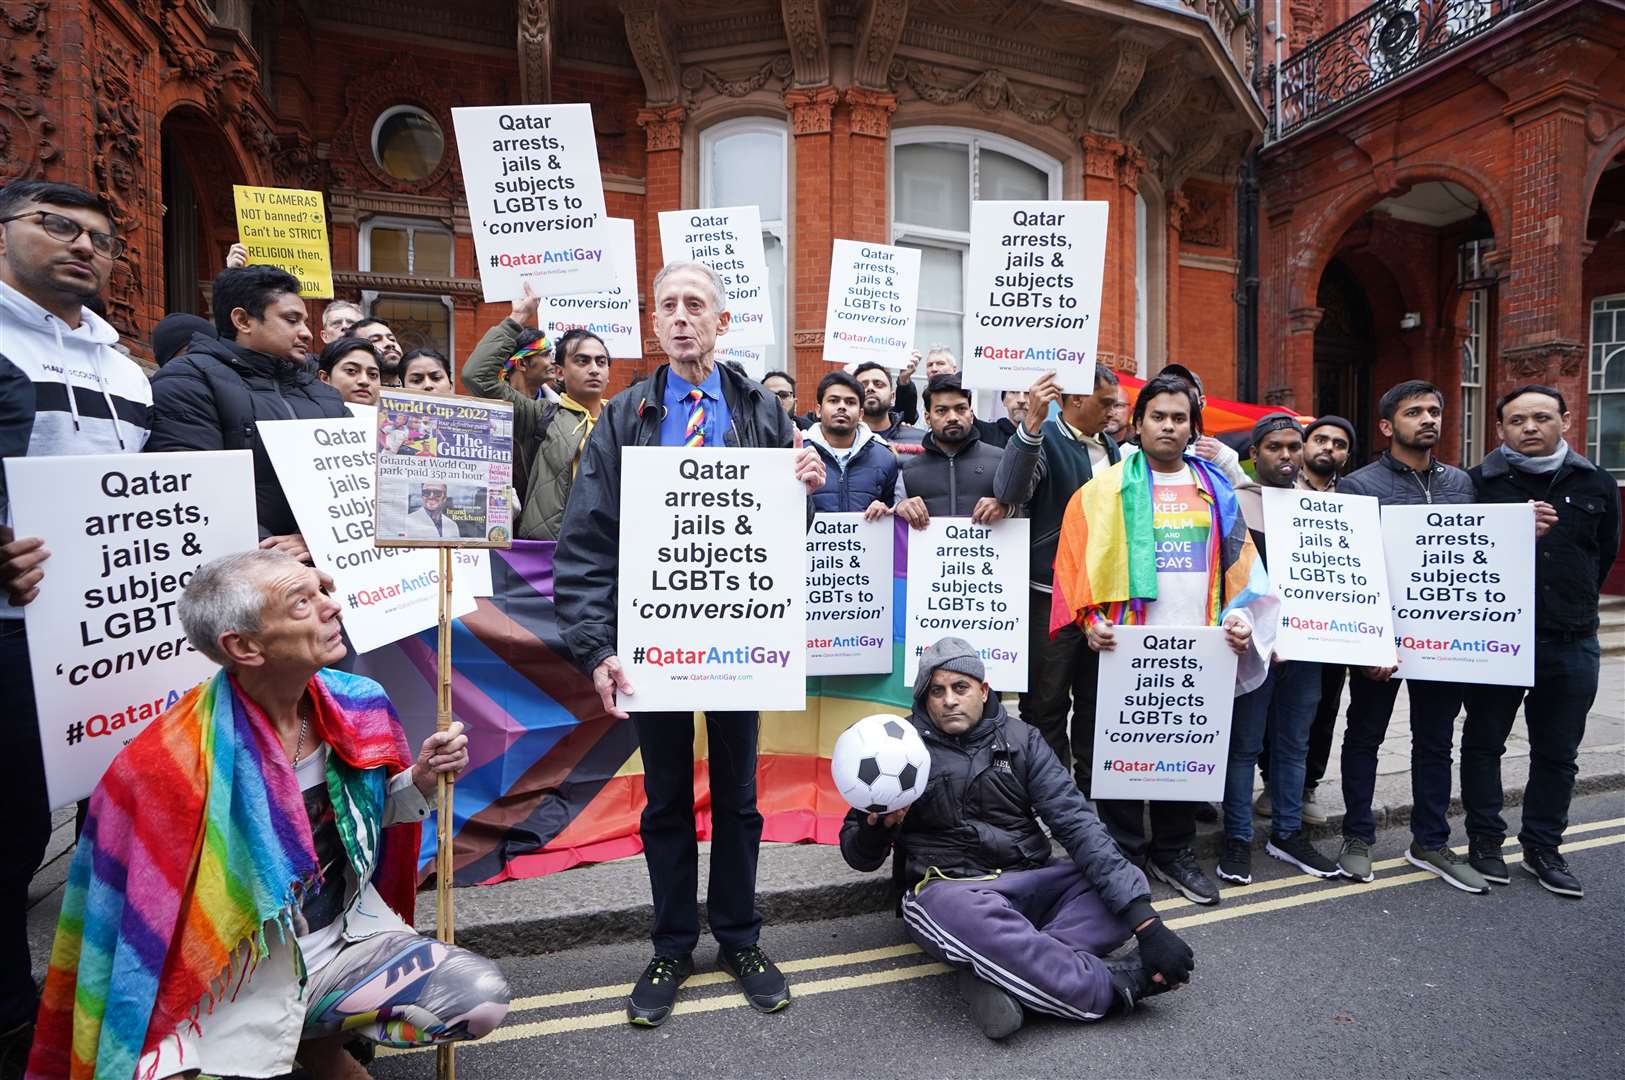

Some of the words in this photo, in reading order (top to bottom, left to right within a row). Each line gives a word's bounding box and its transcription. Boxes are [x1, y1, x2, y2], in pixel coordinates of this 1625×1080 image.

[499, 114, 551, 131] Qatar
[493, 135, 565, 152] arrests,
[502, 156, 541, 176] jails
[548, 154, 562, 170] &
[495, 175, 575, 195] subjects
[252, 192, 265, 204] TV
[269, 193, 317, 207] CAMERAS
[493, 196, 559, 214] LGBTs
[563, 195, 582, 209] to
[241, 208, 261, 220] NOT
[264, 209, 308, 223] banned?
[483, 213, 597, 235] ‘conversion’
[690, 216, 729, 228] Qatar
[1013, 210, 1065, 227] Qatar
[243, 225, 270, 238] Can't
[273, 227, 286, 238] be
[288, 227, 322, 240] STRICT
[685, 230, 738, 243] arrests,
[1001, 232, 1072, 250] arrests,
[248, 246, 294, 259] RELIGION
[297, 249, 323, 262] then,
[490, 248, 602, 268] #QatarAntiGay
[691, 245, 720, 260] jails
[725, 243, 735, 255] &
[861, 248, 894, 261] Qatar
[853, 262, 898, 276] arrests,
[1005, 252, 1044, 271] jails
[1051, 252, 1064, 267] &
[736, 273, 750, 284] to
[855, 272, 881, 285] jails
[885, 276, 893, 287] &
[995, 272, 1074, 291] subjects
[848, 286, 900, 300] subjects
[990, 292, 1052, 308] LGBTs
[1059, 294, 1077, 309] to
[844, 297, 886, 311] LGBTs
[890, 303, 902, 313] to
[976, 312, 1089, 329] ‘conversion’
[832, 331, 907, 349] #QatarAntiGay
[974, 346, 1085, 365] #QatarAntiGay
[381, 398, 424, 414] World
[427, 403, 455, 419] Cup
[457, 406, 488, 420] 2022
[314, 428, 366, 447] Qatar
[453, 433, 483, 448] The
[437, 441, 512, 461] Guardian
[313, 450, 376, 472] arrests
[380, 455, 416, 466] Guards
[429, 460, 457, 469] World
[459, 462, 477, 472] Cup
[380, 466, 403, 477] park
[448, 472, 460, 480] an
[679, 459, 750, 481] Qatar
[101, 470, 192, 498] Qatar
[328, 473, 370, 499] jails
[328, 497, 375, 519] subj
[665, 488, 761, 511] arrests,
[1153, 503, 1188, 513] KEEP
[1299, 497, 1344, 513] Qatar
[85, 502, 209, 536] arrests,
[671, 514, 725, 540] jails
[735, 514, 753, 535] &
[1293, 517, 1353, 535] arrests,
[1427, 513, 1485, 528] Qatar
[331, 520, 374, 544] LGB
[814, 521, 859, 535] Qatar
[946, 525, 992, 540] Qatar
[806, 539, 866, 553] arrests,
[1154, 541, 1192, 553] LOVE
[1299, 532, 1333, 549] jails
[1338, 535, 1350, 549] &
[1416, 532, 1495, 548] arrests,
[101, 539, 170, 578] jails
[181, 532, 203, 556] &
[658, 542, 767, 568] subjects
[936, 544, 999, 560] arrests,
[1292, 551, 1361, 568] subjects
[1421, 550, 1465, 568] jails
[1472, 550, 1488, 564] &
[810, 556, 844, 573] jails
[849, 555, 861, 568] &
[940, 561, 975, 578] jails
[981, 561, 993, 575] &
[1155, 556, 1193, 569] GAYS
[652, 570, 740, 591] LGBTs
[748, 571, 774, 591] to
[1290, 567, 1346, 584] LGBTs
[1351, 573, 1367, 586] to
[1411, 569, 1500, 587] subjects
[84, 565, 201, 609] subjec
[348, 570, 441, 609] #QatarAntiG
[932, 579, 1003, 597] subjects
[1279, 584, 1380, 605] ‘conversion’
[1407, 587, 1477, 602] LGBTs
[1484, 589, 1506, 603] to
[806, 590, 853, 603] GBTs
[858, 590, 874, 603] to
[928, 597, 985, 612] LGBTs
[990, 599, 1007, 612] to
[633, 598, 791, 619] ‘conversion’
[1392, 605, 1522, 622] ‘conversion’
[80, 601, 181, 647] LGBT
[915, 615, 1019, 631] ‘conversion’
[1281, 616, 1384, 638] #QatarAntiGay
[806, 636, 884, 648] atarAntiGay
[1143, 635, 1196, 651] Qatar
[1394, 636, 1521, 656] #QatarAntiGay
[632, 646, 790, 668] #QatarAntiGay
[1131, 655, 1203, 672] arrests,
[670, 673, 753, 681] www.QatarAntiGay.com
[1135, 674, 1175, 691] jails
[1181, 673, 1195, 688] &
[1124, 692, 1204, 710] subjects
[1119, 711, 1183, 725] LGBTs
[1189, 712, 1207, 725] to
[1105, 729, 1220, 744] ‘conversion’
[1103, 760, 1216, 775] #QatarAntiGay
